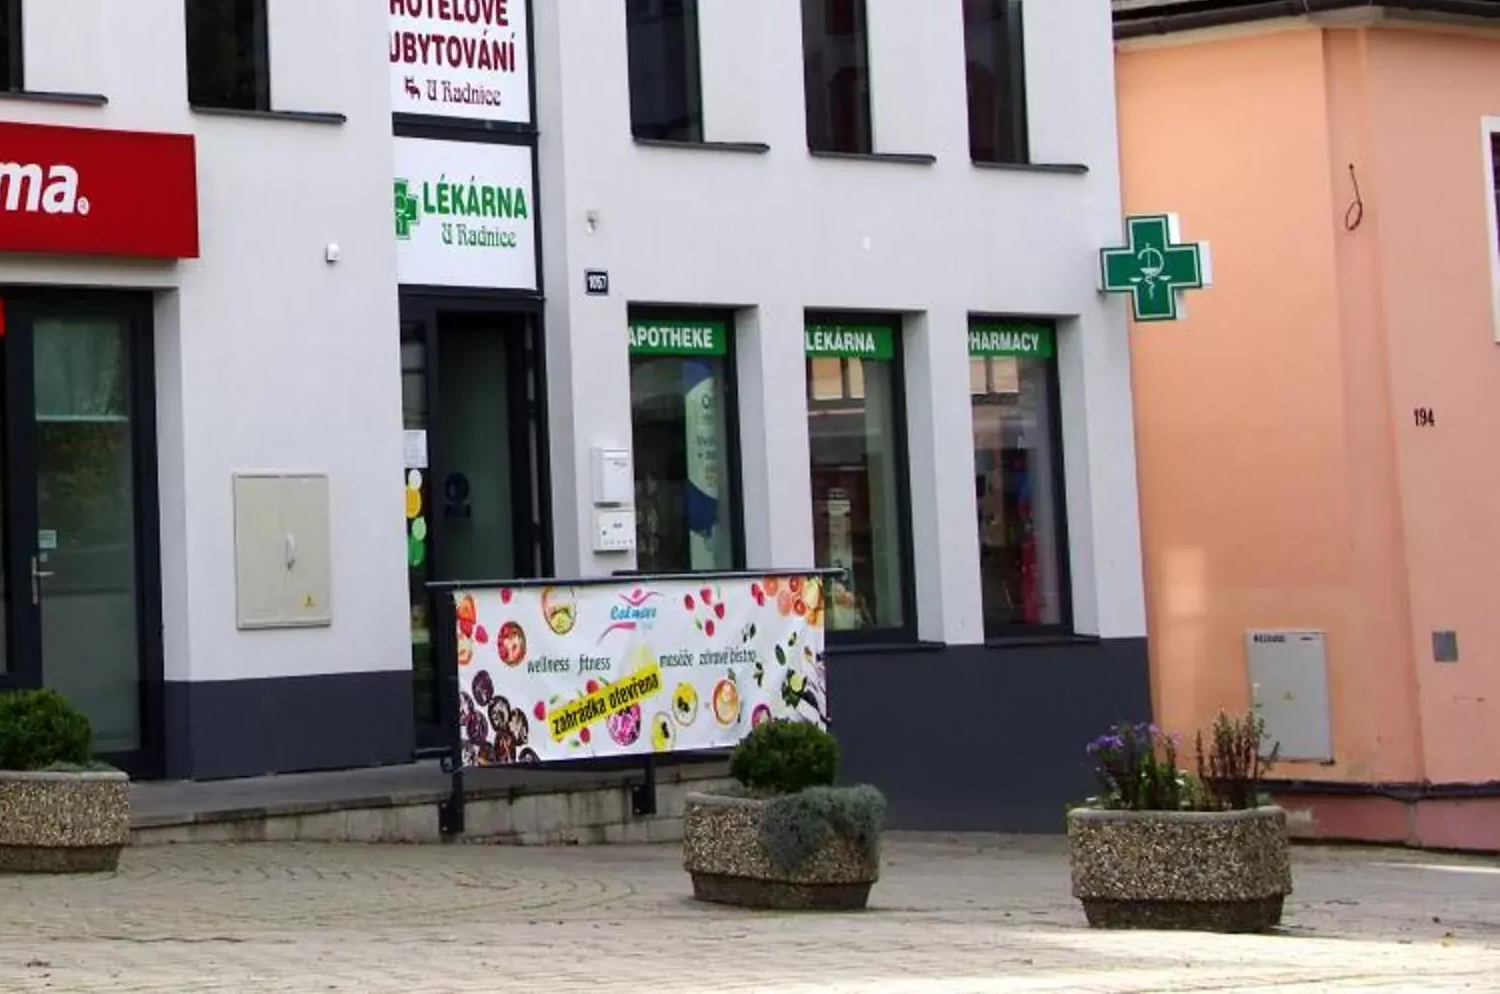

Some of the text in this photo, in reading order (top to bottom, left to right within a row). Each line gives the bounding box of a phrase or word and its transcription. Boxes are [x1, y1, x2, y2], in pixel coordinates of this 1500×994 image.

[441, 80, 502, 107] Radnice
[423, 173, 528, 219] LÉKÁRNA
[456, 223, 517, 248] Radnice
[627, 326, 714, 349] APOTHEKE
[968, 331, 1039, 351] HARMACY
[1413, 407, 1435, 427] 194
[527, 654, 611, 675] wellness fitness
